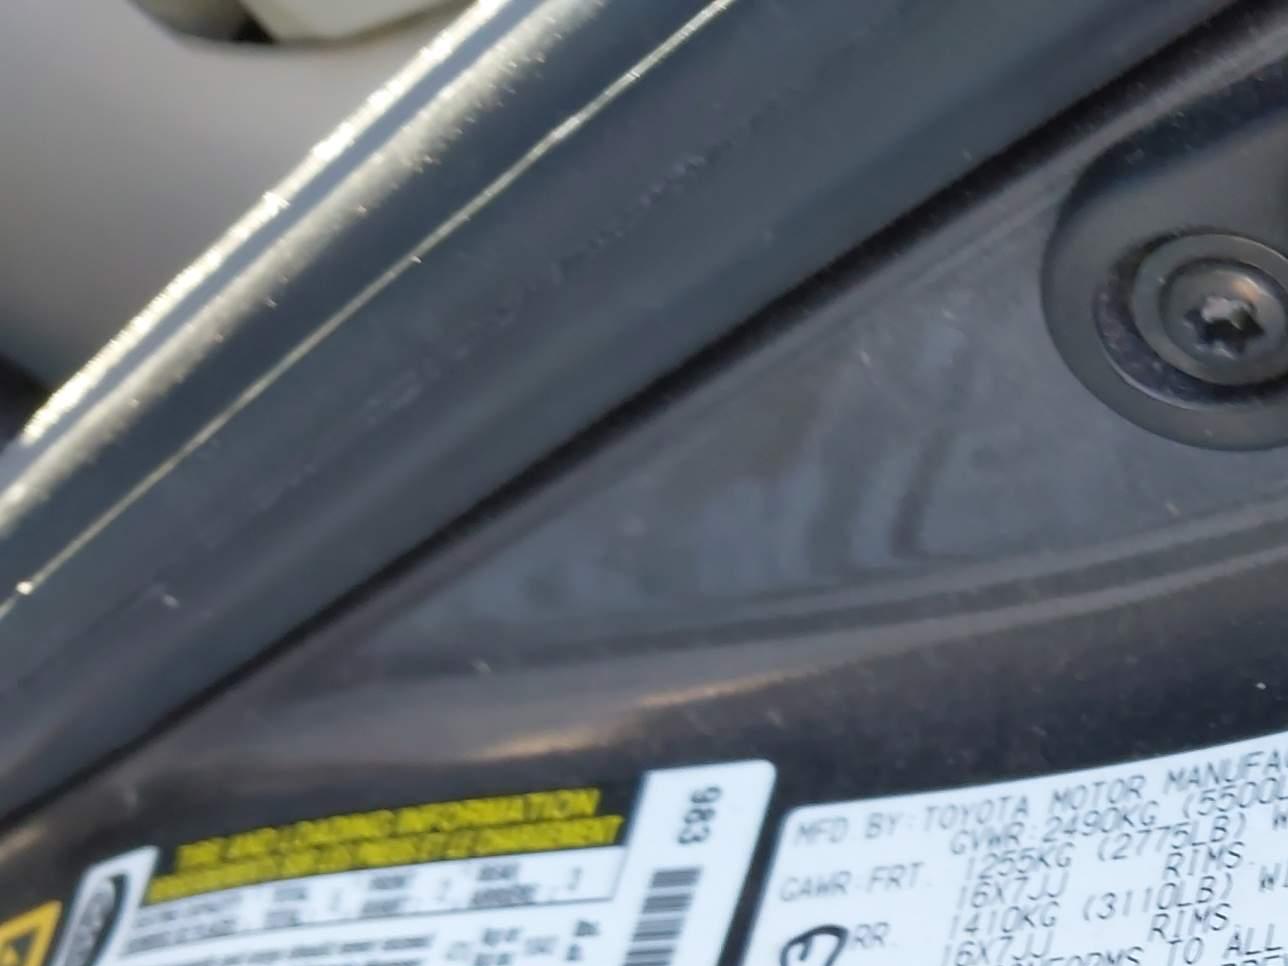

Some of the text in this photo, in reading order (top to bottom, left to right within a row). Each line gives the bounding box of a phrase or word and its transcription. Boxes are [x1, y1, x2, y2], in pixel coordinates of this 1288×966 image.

[677, 786, 722, 846] 983
[1049, 775, 1145, 815] MOTOR
[965, 841, 1075, 884] 1255KG
[1097, 812, 1247, 862] (2775LB)
[950, 900, 1060, 940] 1410KG
[1083, 872, 1234, 921] (3110LB)
[957, 869, 1070, 910] 16X7JJ
[1222, 923, 1284, 959] ALL
